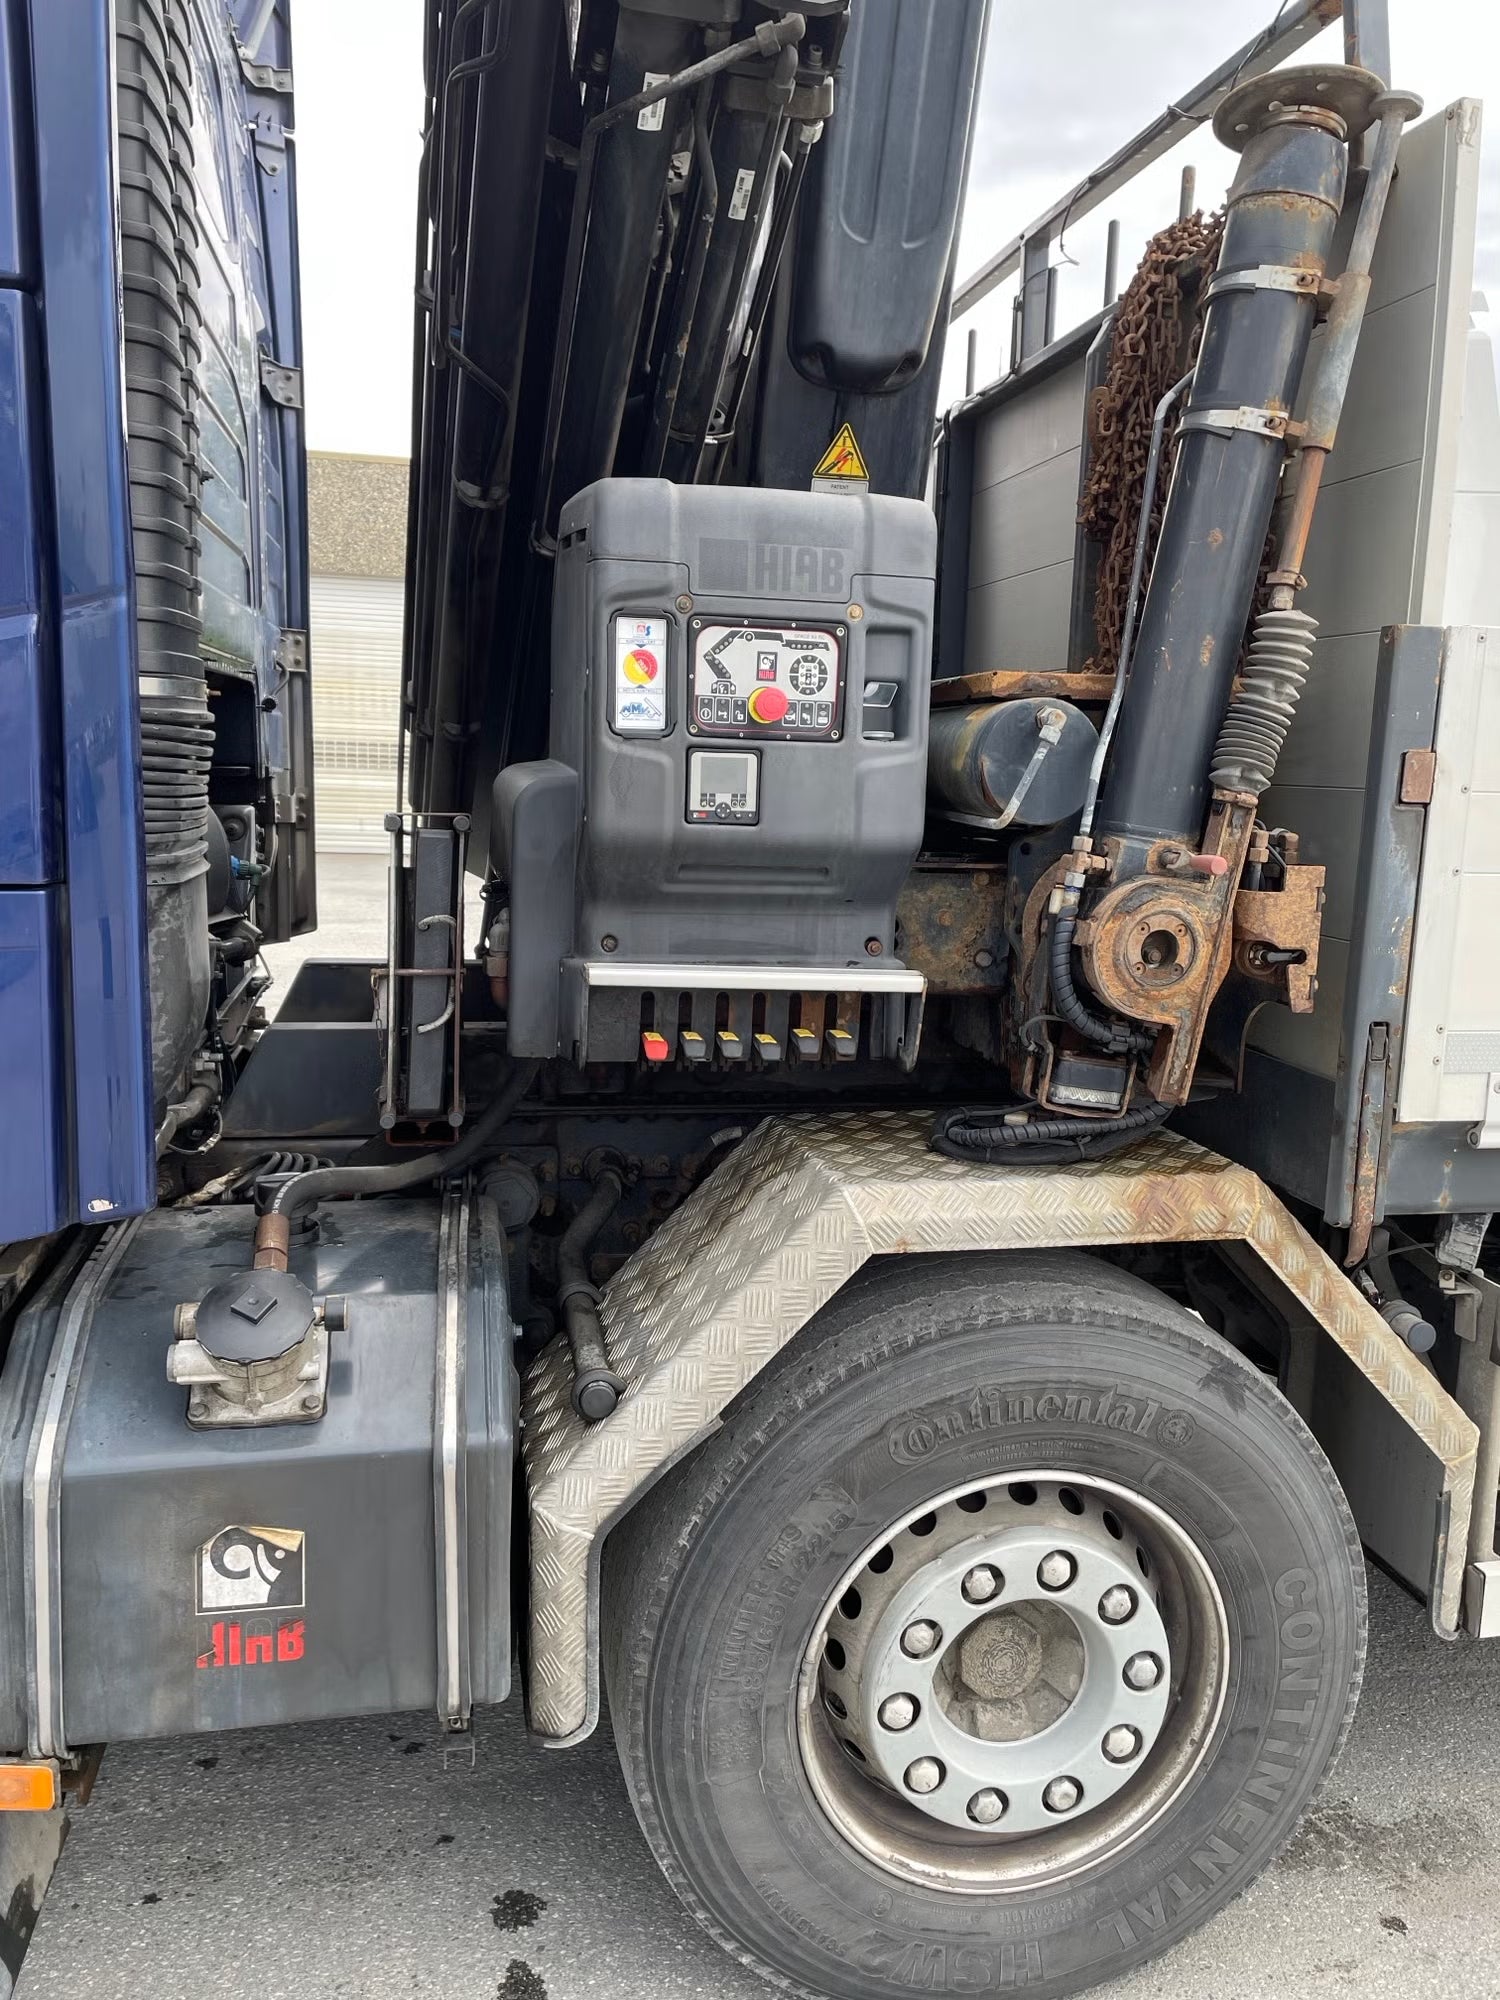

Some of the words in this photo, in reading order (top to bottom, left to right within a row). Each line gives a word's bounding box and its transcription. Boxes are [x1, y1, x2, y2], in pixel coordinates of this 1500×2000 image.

[755, 545, 844, 594] HIAB
[888, 1383, 1163, 1466] Continental
[781, 1575, 802, 1599] R
[719, 1580, 770, 1681] WINTER
[1097, 1566, 1324, 1950] CONTINENTAL
